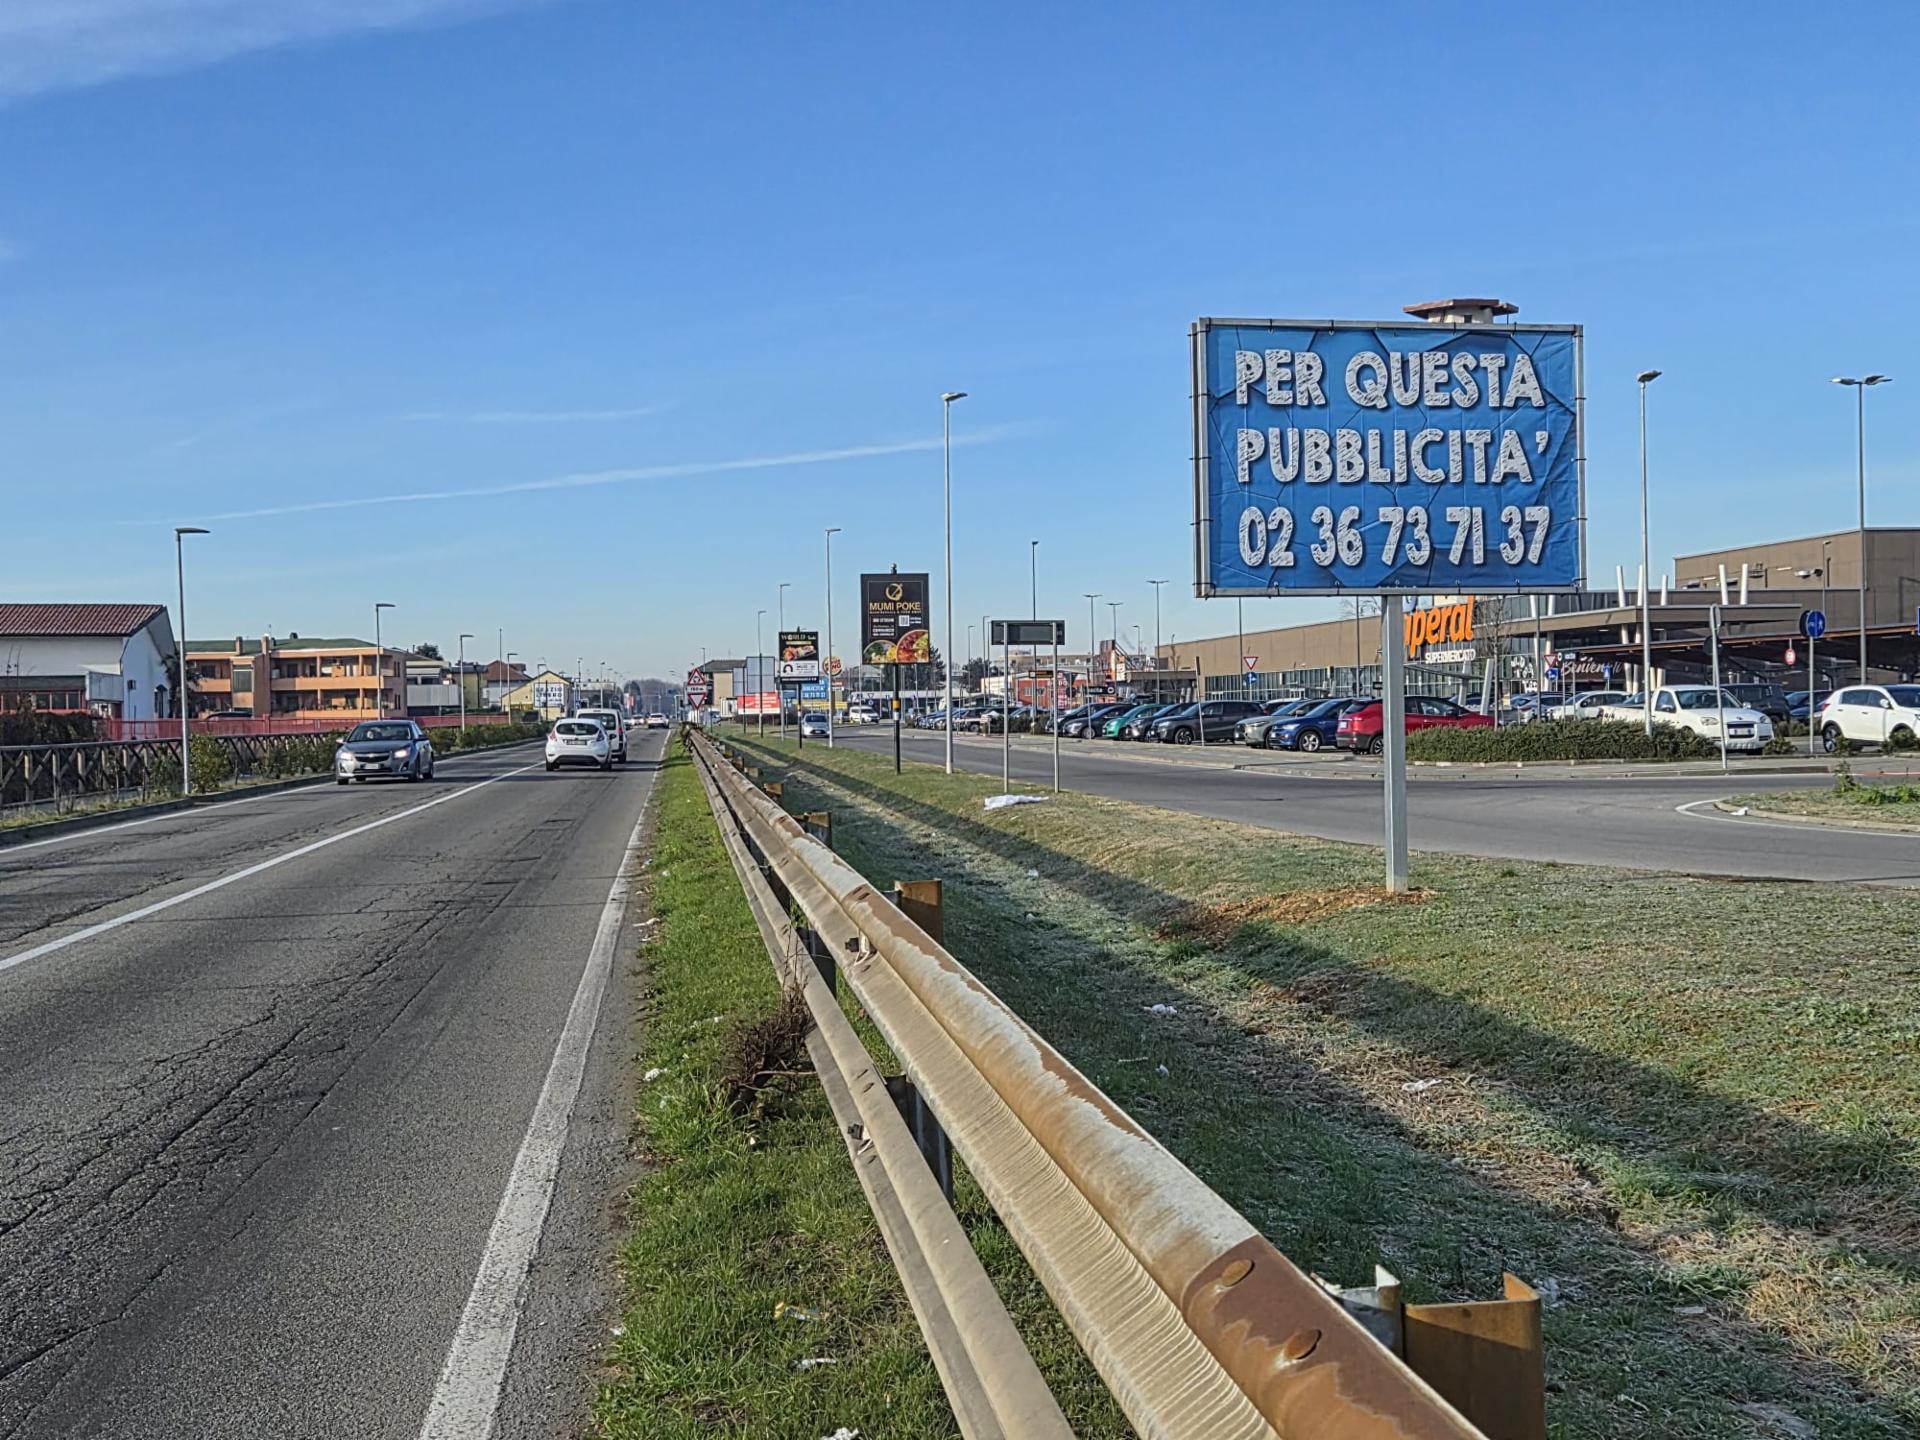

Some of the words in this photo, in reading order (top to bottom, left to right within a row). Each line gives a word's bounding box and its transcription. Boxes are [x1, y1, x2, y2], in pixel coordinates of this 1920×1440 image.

[1235, 349, 1326, 406] PER
[1344, 350, 1545, 409] QUESTA
[1237, 428, 1551, 484] PUBBLICITA'
[1239, 506, 1295, 567] 02
[1310, 506, 1363, 567] 36
[1379, 506, 1431, 567] 73
[1446, 507, 1485, 565] 71
[1500, 506, 1551, 566] 37
[869, 602, 894, 611] MUMI
[896, 602, 921, 611] POKE
[1425, 648, 1476, 664] SUPERMERCATO
